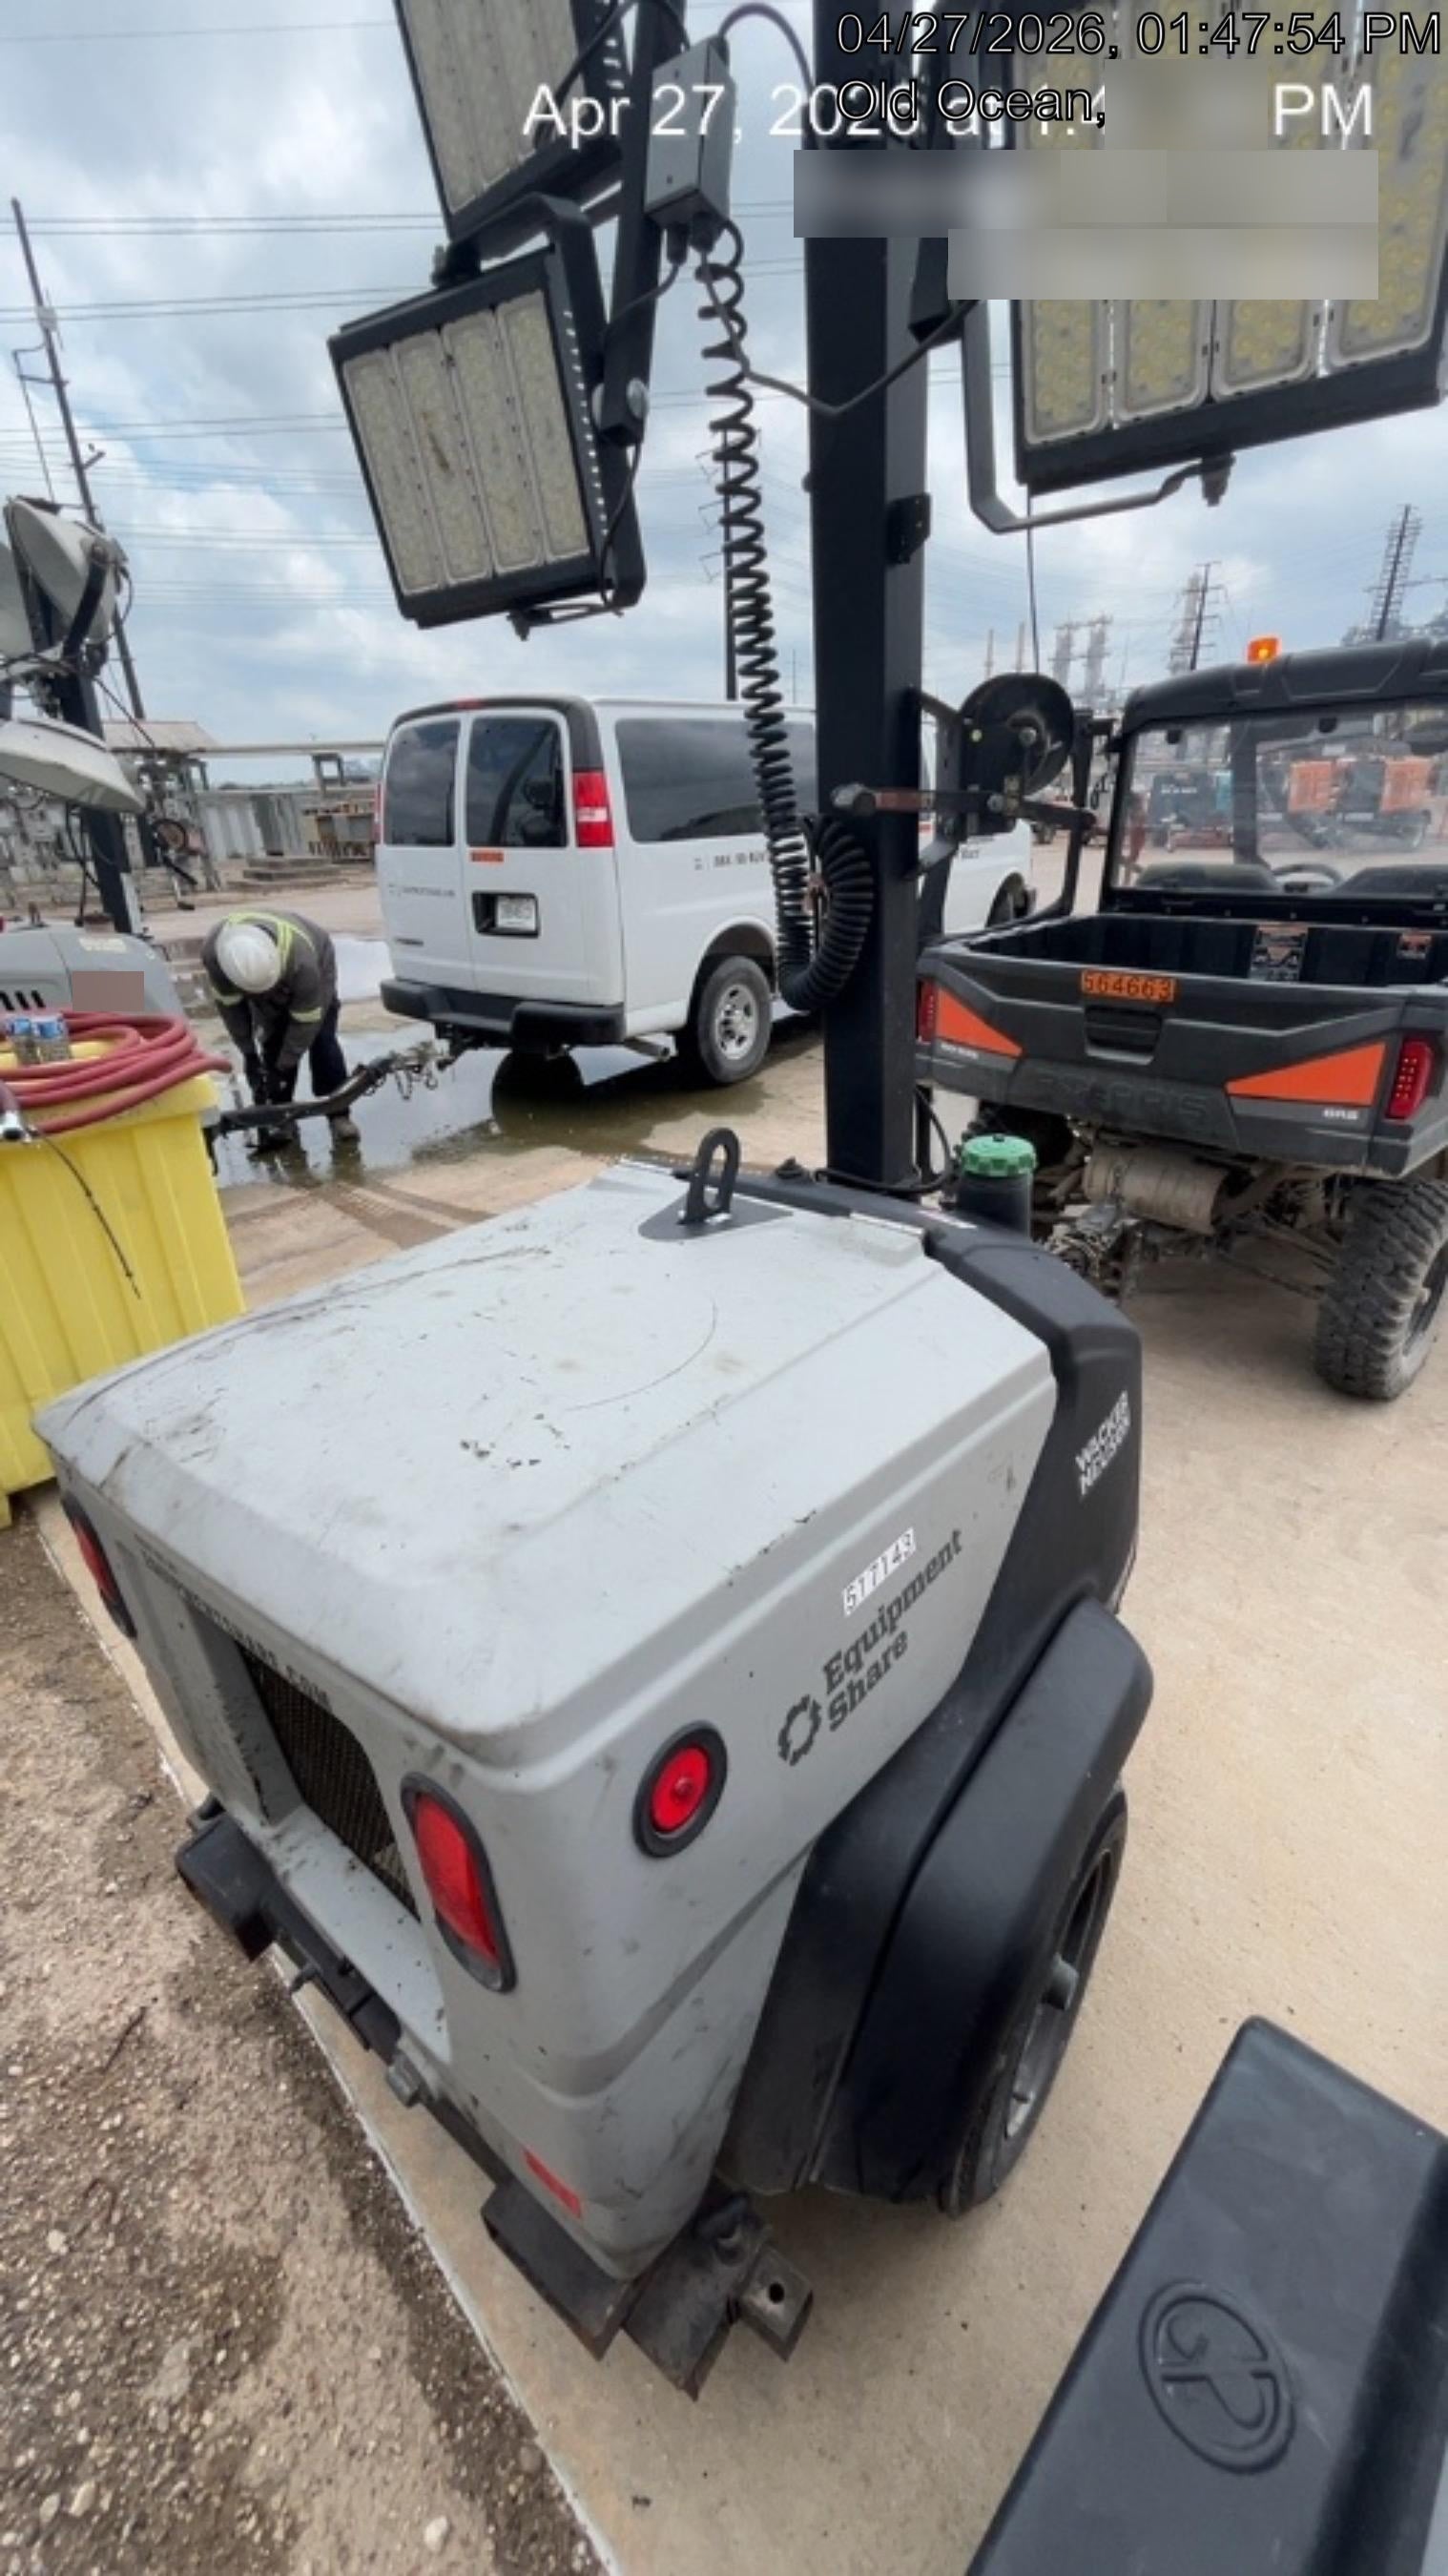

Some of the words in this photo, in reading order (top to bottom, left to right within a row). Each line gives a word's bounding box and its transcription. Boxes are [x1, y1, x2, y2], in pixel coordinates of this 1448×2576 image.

[1074, 1390, 1130, 1471] WACKER
[822, 1528, 962, 1696] Equipment
[843, 1531, 914, 1612] 517143
[827, 1631, 908, 1733] Share
